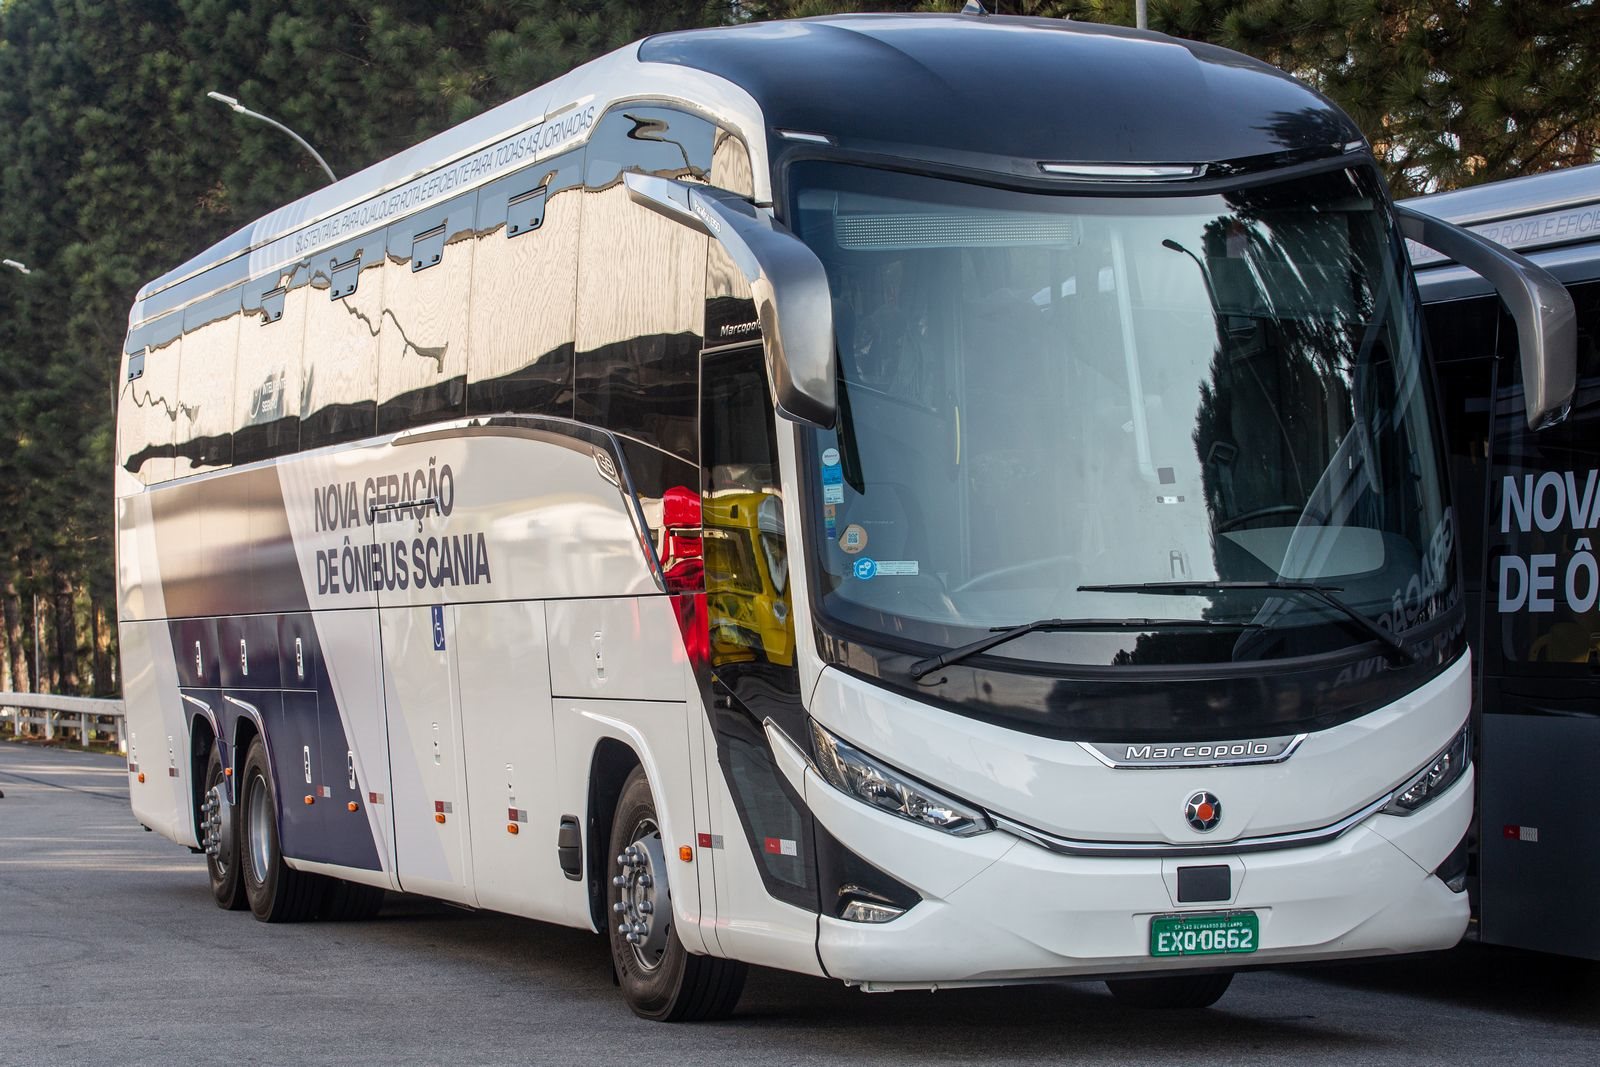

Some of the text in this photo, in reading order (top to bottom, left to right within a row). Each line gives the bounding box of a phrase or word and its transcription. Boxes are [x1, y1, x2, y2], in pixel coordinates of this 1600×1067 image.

[340, 211, 360, 232] PARA
[360, 194, 401, 226] QUALQUER
[400, 186, 421, 209] ROTA
[421, 181, 429, 201] E
[428, 162, 473, 197] EFICIENTE
[469, 151, 492, 179] PARA
[494, 138, 526, 169] TODAS
[525, 131, 541, 155] AS
[539, 106, 594, 151] JORNADAS
[1500, 221, 1540, 244] ROTA
[1542, 218, 1555, 238] E
[314, 455, 454, 534] NOVA GERAÇÃO
[316, 532, 491, 595] DE ÔNIBUS SCANIA
[1498, 537, 1600, 614] DE Ô
[1125, 741, 1269, 760] Marcopolo
